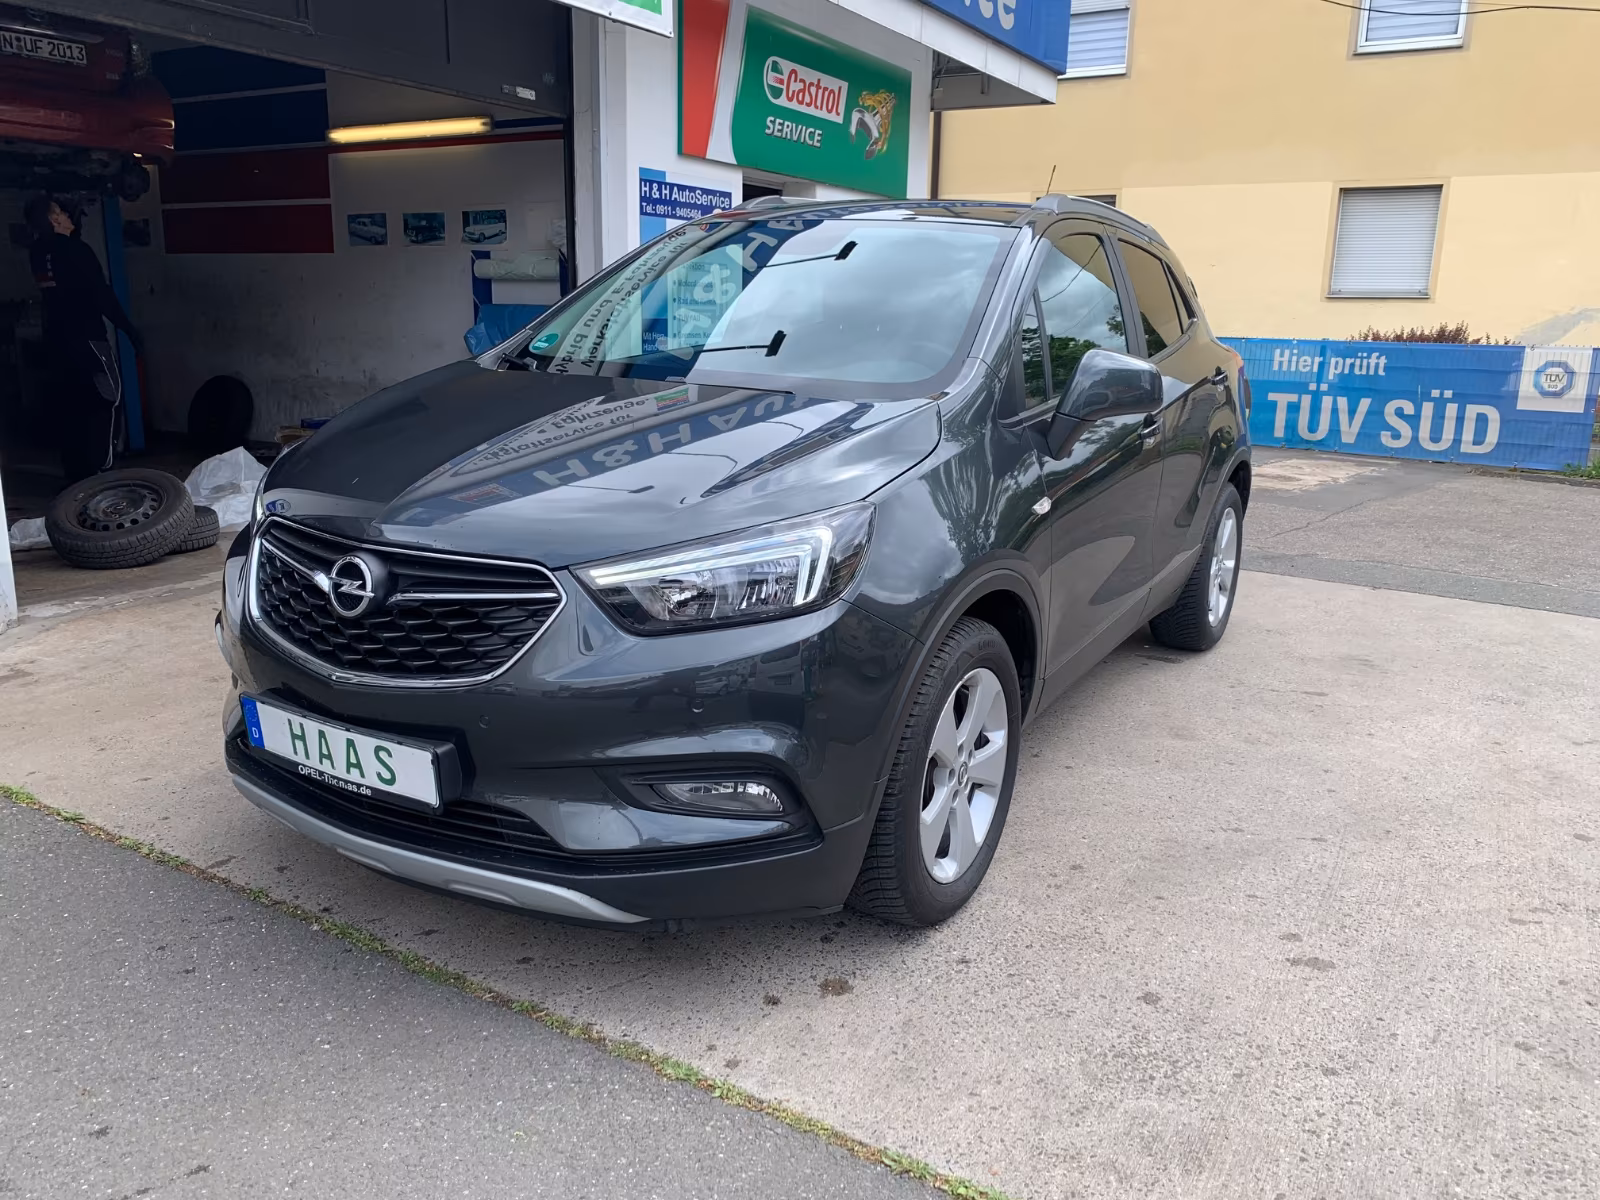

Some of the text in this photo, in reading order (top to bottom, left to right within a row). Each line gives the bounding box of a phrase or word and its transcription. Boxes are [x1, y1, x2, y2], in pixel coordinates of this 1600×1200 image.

[1, 33, 14, 50] N
[23, 37, 43, 54] UF
[47, 41, 85, 62] 2013
[785, 68, 843, 117] Castrol
[765, 116, 823, 148] SERVICE
[641, 181, 730, 209] H & H AutoService
[656, 204, 672, 216] 0911
[1272, 349, 1388, 380] Hier prüft
[1544, 372, 1566, 382] TÜV
[1267, 383, 1501, 455] TÜV SÜD
[252, 727, 259, 738] D
[287, 718, 397, 787] HAAS
